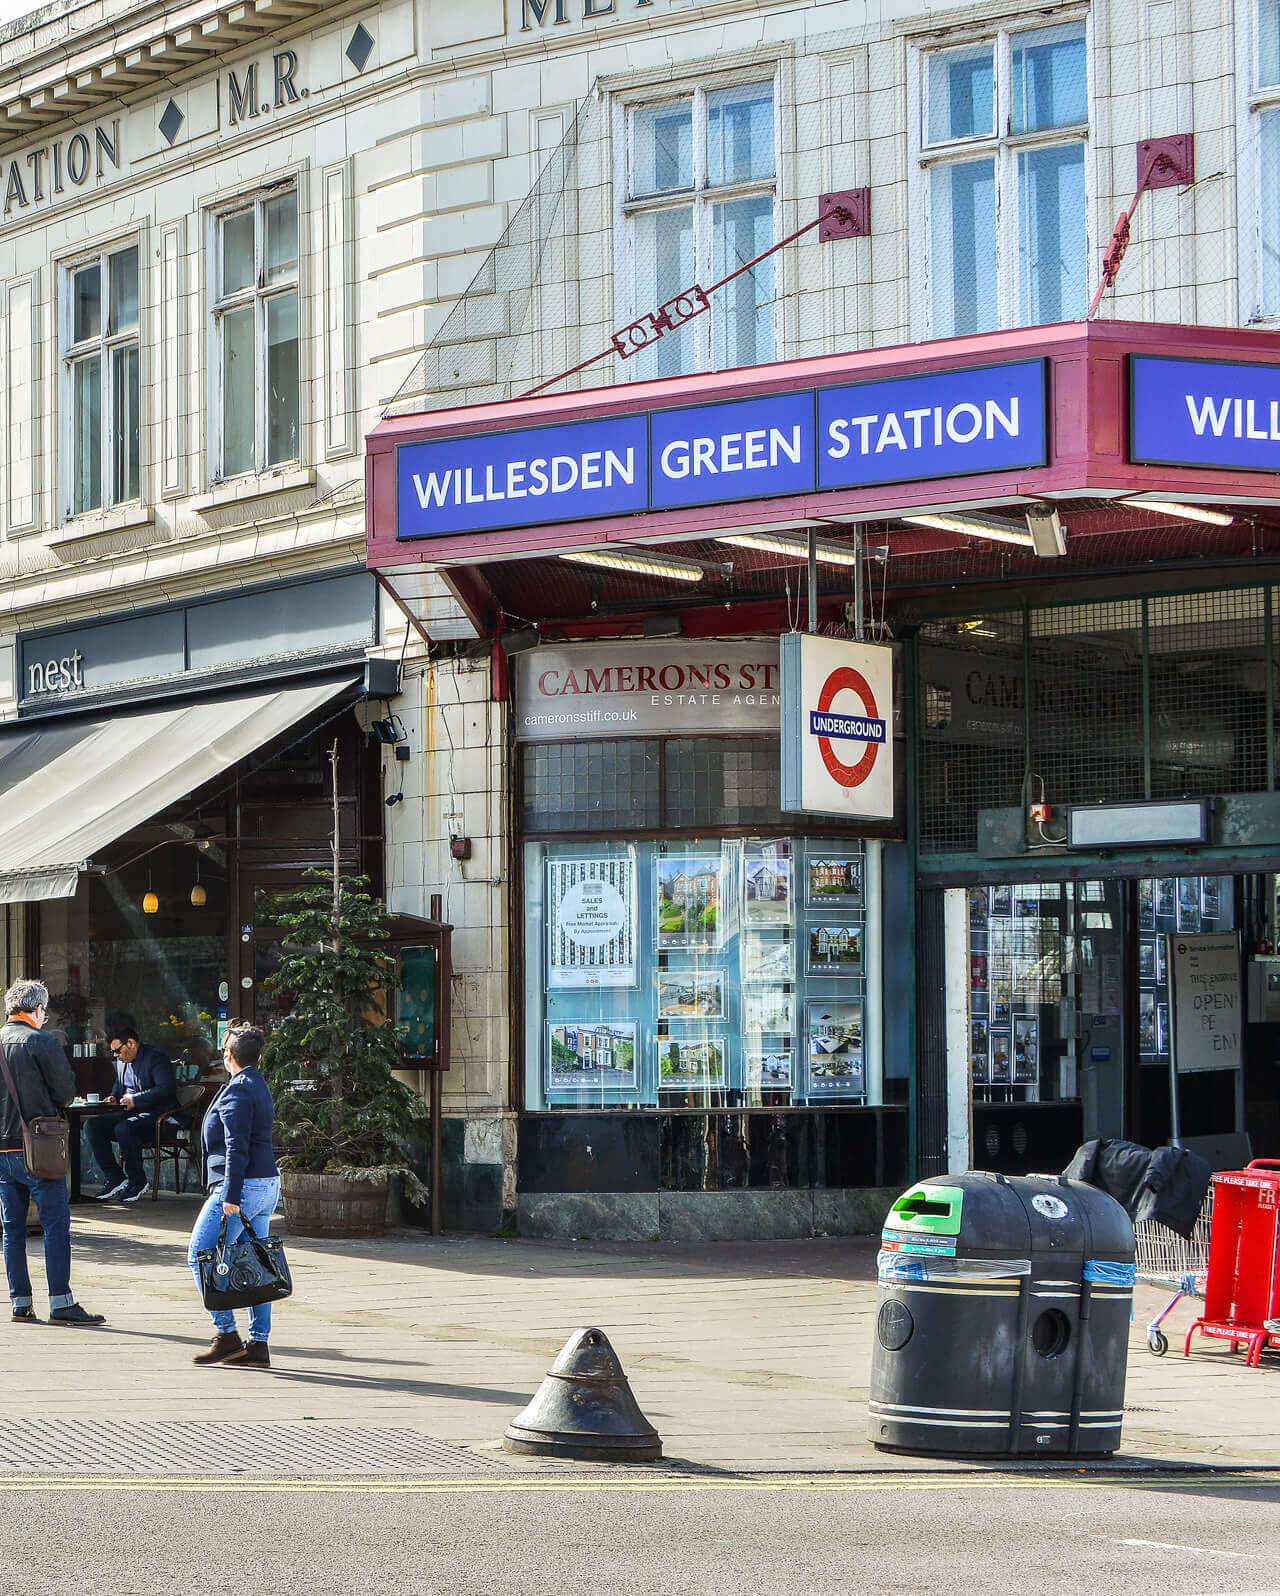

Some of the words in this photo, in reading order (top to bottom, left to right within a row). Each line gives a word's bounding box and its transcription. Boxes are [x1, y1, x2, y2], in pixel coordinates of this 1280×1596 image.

[226, 48, 310, 126] M.R.
[412, 446, 636, 510] WILLESDEN
[660, 425, 802, 480] GREEN
[827, 396, 1020, 460] STATION
[28, 648, 84, 694] nest
[538, 663, 732, 697] CAMERONS
[651, 695, 721, 706] ESTATE
[524, 708, 638, 726] cameronsstiff.co.uk
[813, 715, 883, 739] UNDERGROUND
[1224, 1176, 1245, 1186] PLEASE
